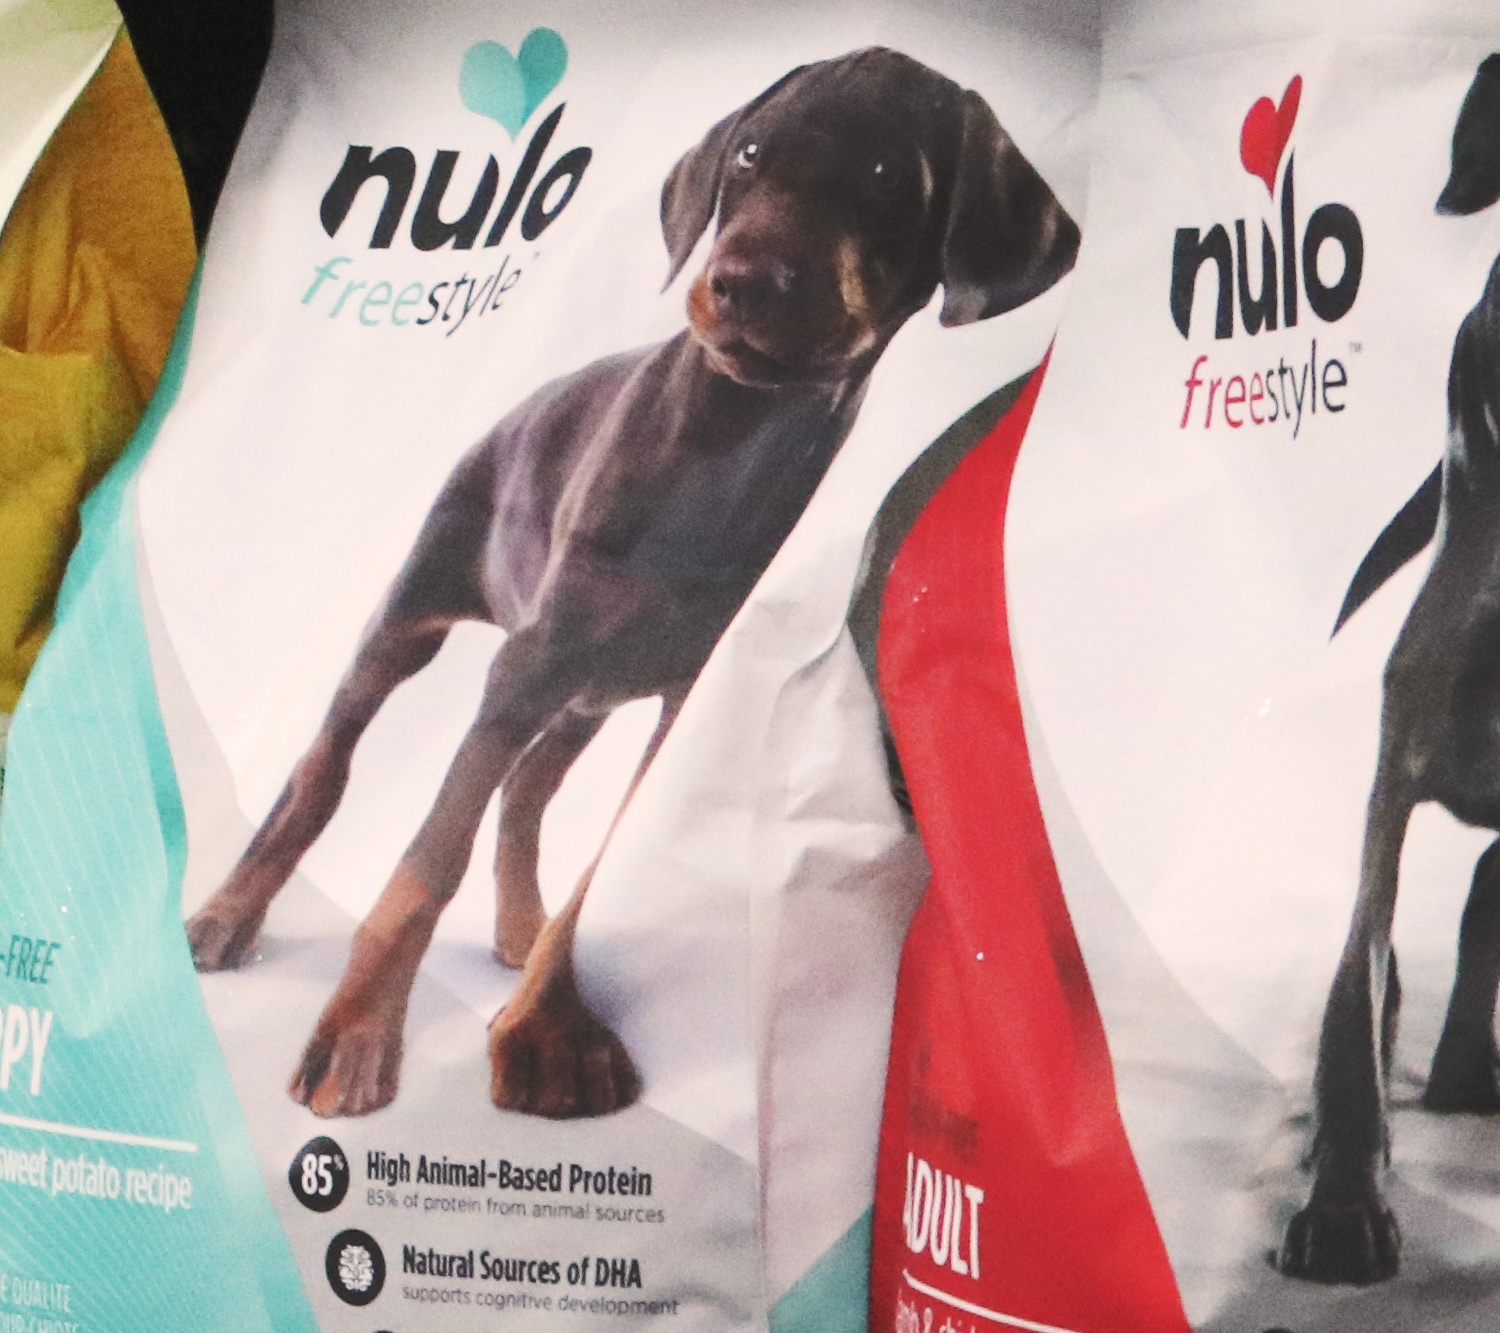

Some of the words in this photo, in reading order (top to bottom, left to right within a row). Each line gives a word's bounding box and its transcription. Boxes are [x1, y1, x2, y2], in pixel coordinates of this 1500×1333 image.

[319, 102, 592, 252] nulo
[1170, 146, 1364, 341] nulo
[298, 255, 522, 338] freestyle
[1179, 337, 1349, 439] freestyle
[52, 1154, 121, 1197] potato
[123, 1162, 194, 1215] recipe
[367, 1151, 411, 1183] High
[417, 1155, 562, 1192] Animal-Based
[569, 1166, 652, 1197] Protein
[402, 1285, 472, 1306] supports
[476, 1288, 552, 1313] cognitive
[559, 1292, 680, 1317] development
[403, 1244, 474, 1279] Natural
[480, 1250, 561, 1285] Sources
[567, 1255, 590, 1286] of
[596, 1258, 643, 1289] DHA
